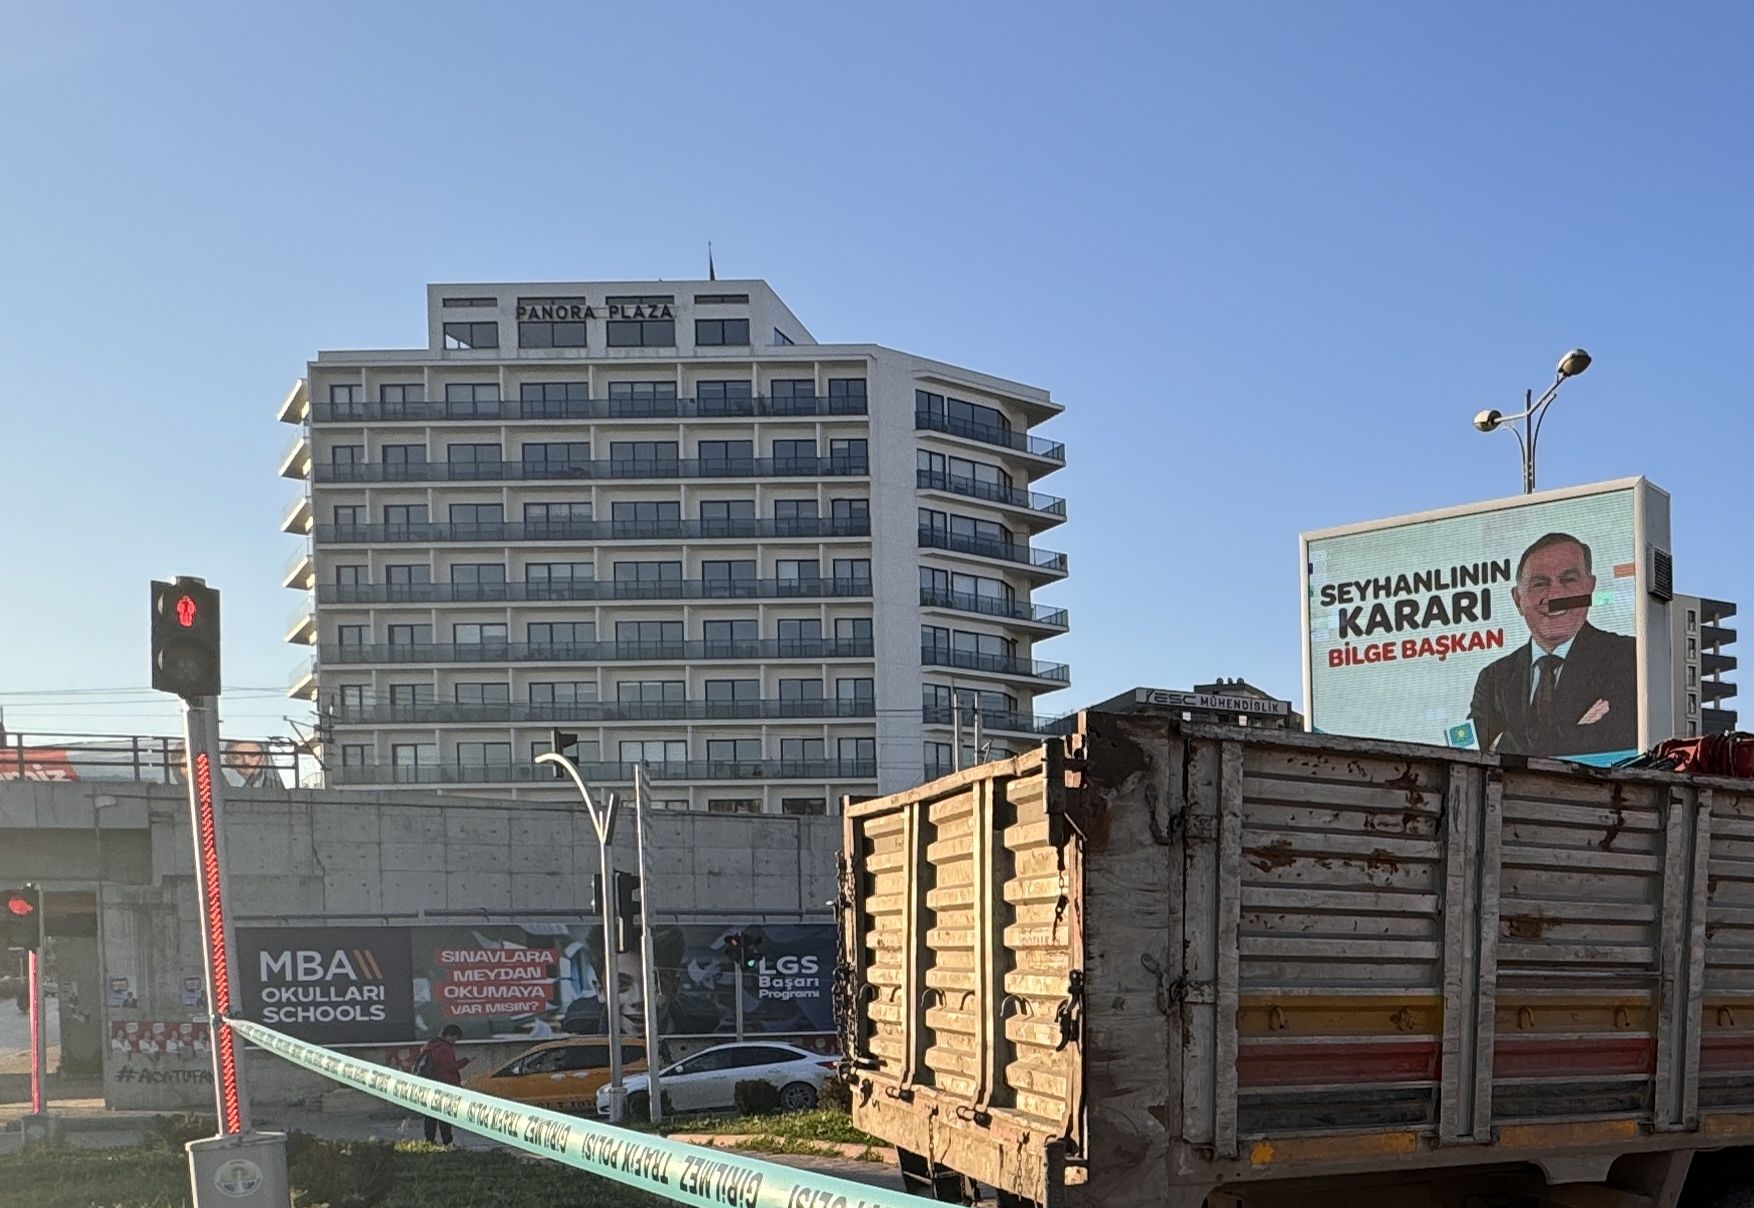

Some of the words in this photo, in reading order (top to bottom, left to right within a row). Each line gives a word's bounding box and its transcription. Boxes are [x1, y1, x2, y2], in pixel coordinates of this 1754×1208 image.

[516, 305, 595, 320] PANORA
[608, 304, 674, 319] PLAZA
[1320, 558, 1511, 607] SEYHANLININ
[1338, 588, 1492, 639] KARARI
[1328, 641, 1397, 668] BİLGE
[1401, 628, 1504, 661] BAŞKAN
[1200, 695, 1280, 714] MÜHENDİSLİK
[440, 950, 554, 963] SINAVLARA
[758, 955, 819, 975] LGS
[259, 950, 358, 982] MBA
[453, 966, 541, 982] MEYDAN
[443, 985, 545, 998] OKUMAYA
[758, 975, 820, 990] Başarı
[261, 985, 385, 1003] OKULLARI
[758, 988, 820, 1000] Programı
[262, 1004, 386, 1023] SCHOOLS
[450, 1003, 482, 1015] VAR
[485, 1001, 540, 1014] MISIN?
[621, 1141, 673, 1185] TRAFİK
